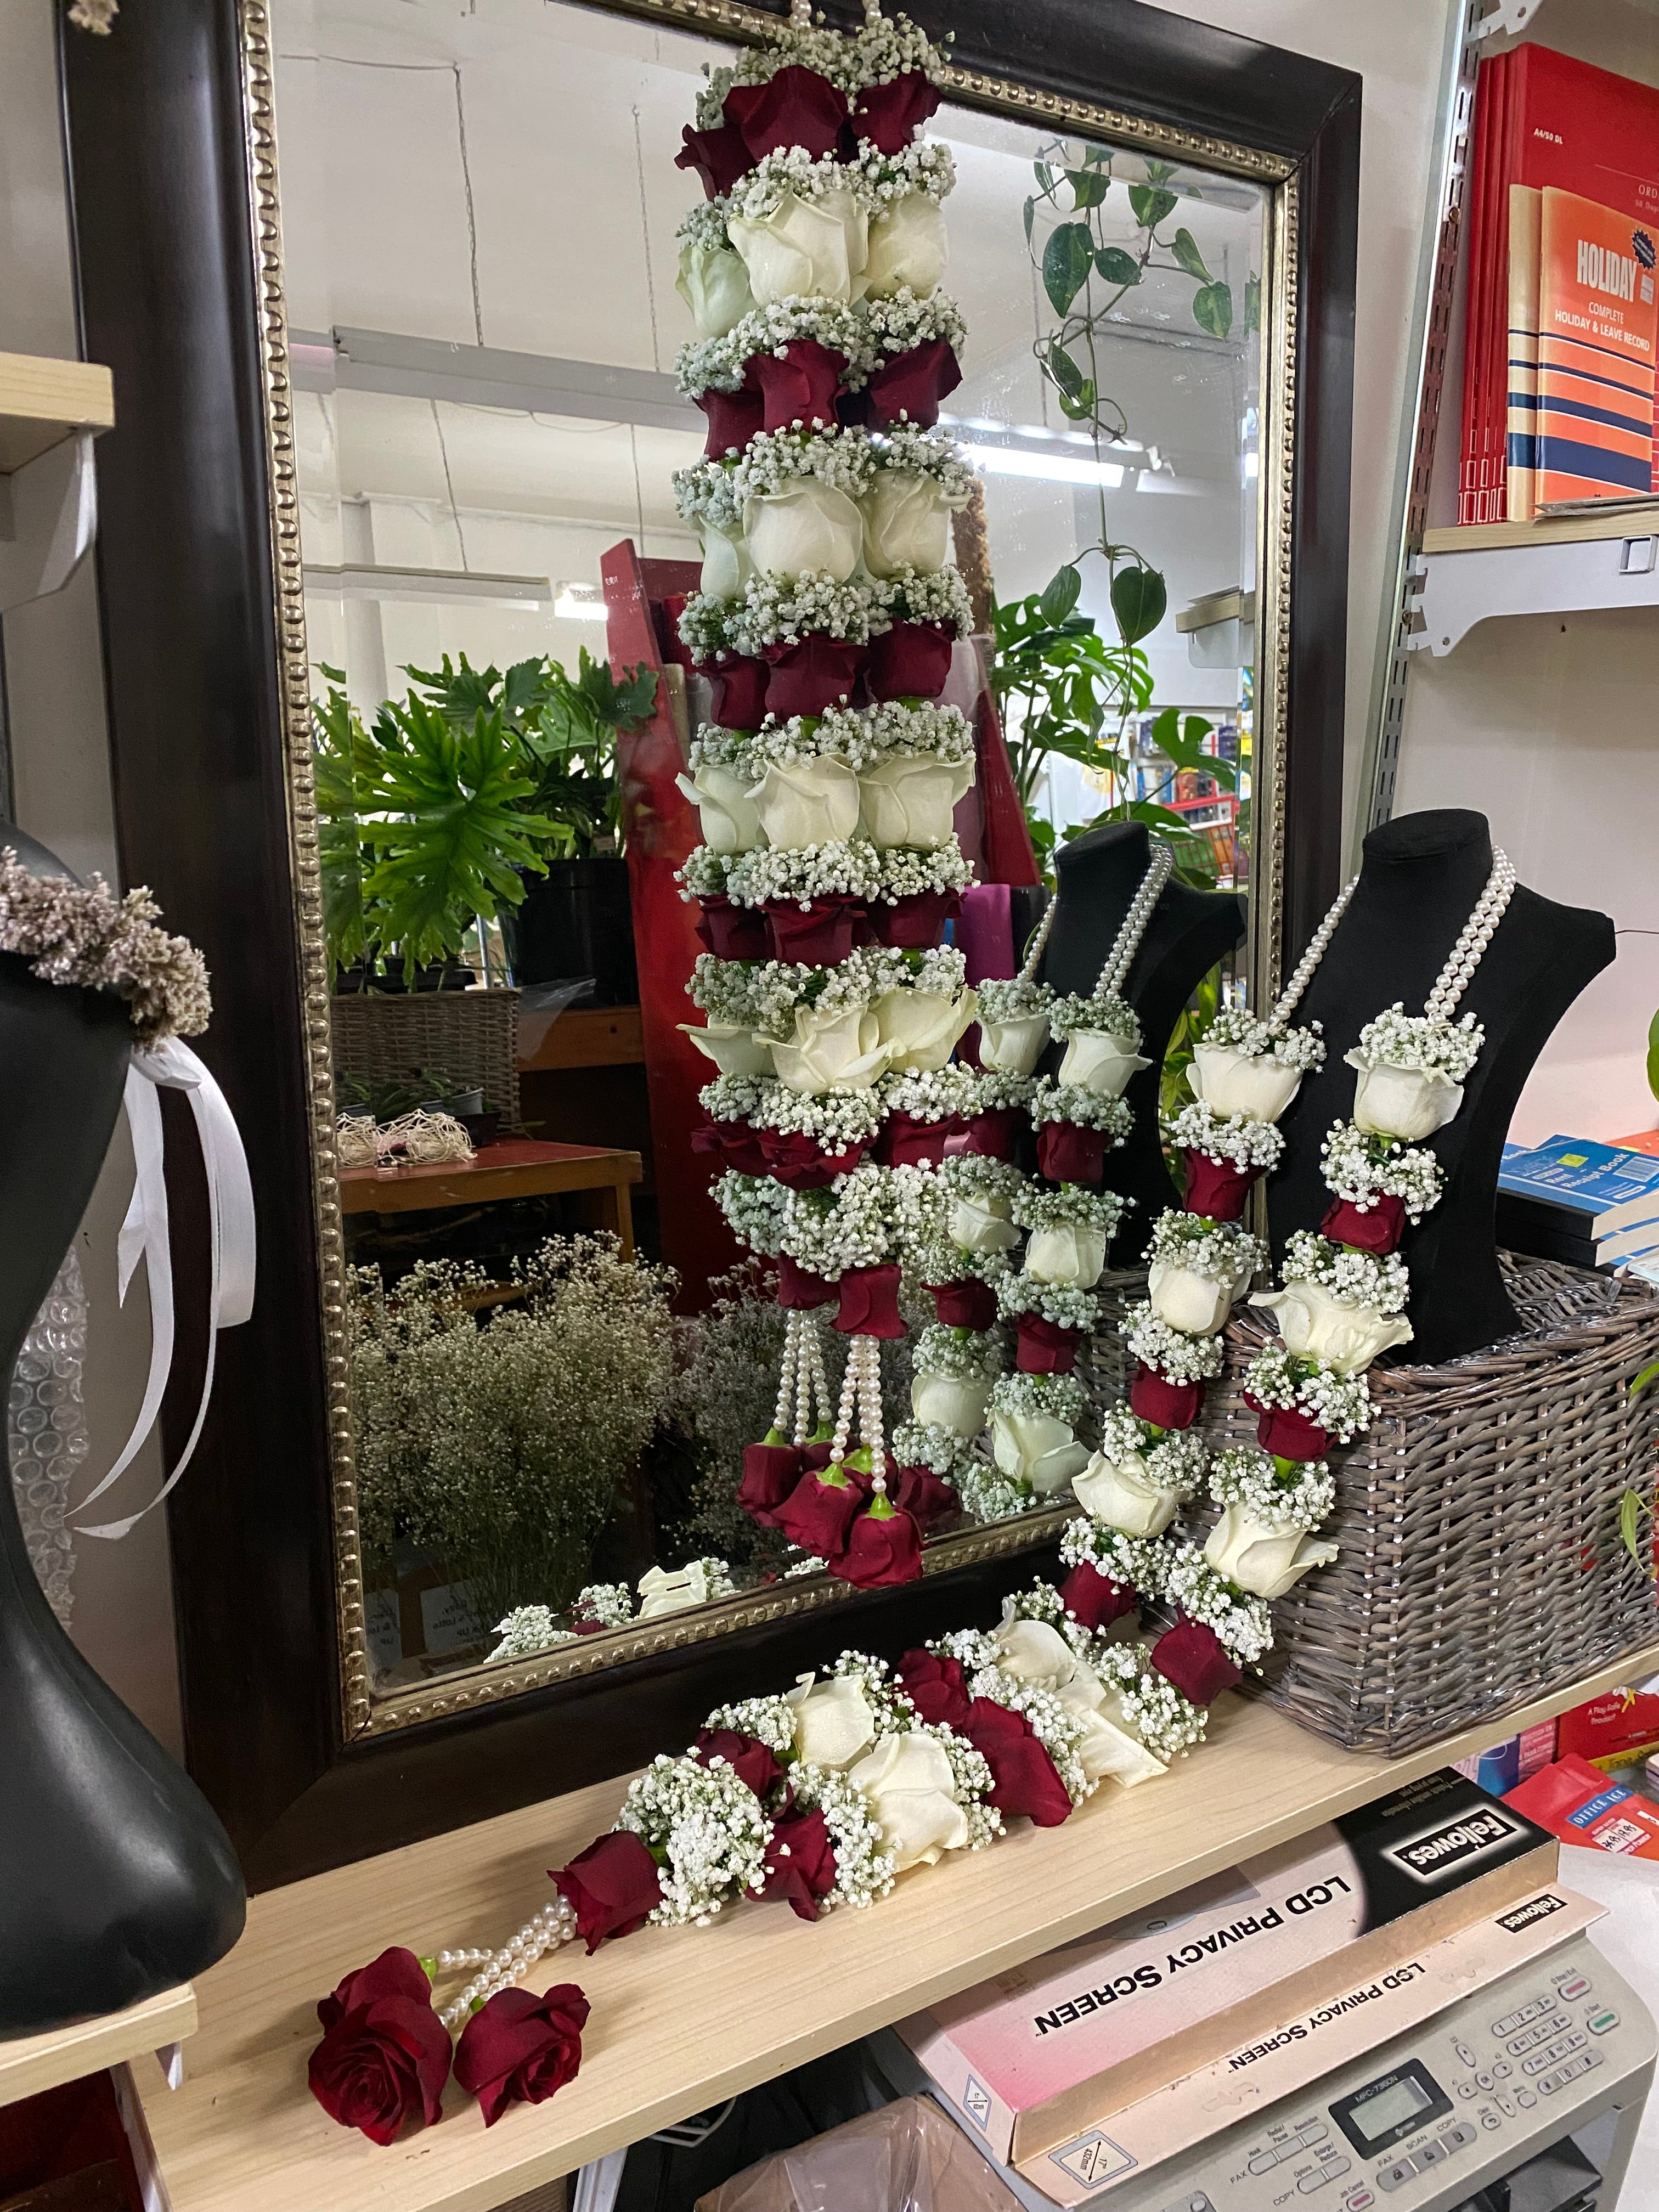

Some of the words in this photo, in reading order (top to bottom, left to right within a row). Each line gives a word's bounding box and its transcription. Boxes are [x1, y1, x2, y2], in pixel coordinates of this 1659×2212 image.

[1533, 128, 1554, 141] A4/50
[1555, 134, 1564, 144] DL
[1577, 239, 1638, 302] HOLIDAY
[1589, 301, 1624, 324] COMPLETE
[1555, 309, 1591, 330] HOLIDAY
[1592, 320, 1599, 334] &
[1600, 323, 1623, 341] LEAVE
[1624, 331, 1650, 351] RECORD
[1545, 1173, 1575, 1184] Rent
[1561, 1171, 1605, 1188] Receipt
[1598, 1153, 1630, 1172] Book
[1573, 1798, 1608, 1824] OFFICE
[1606, 1789, 1627, 1803] ICE
[1406, 1815, 1508, 1865] Fellowes
[1285, 1876, 1352, 1915] LCD
[1503, 1897, 1562, 1928] Fellowes
[1166, 1907, 1285, 1974] PRIVACY
[1034, 1965, 1163, 2036] SCREEN
[1308, 1984, 1384, 2029] PRIVACY
[1518, 2013, 1525, 2021] 2
[1537, 2001, 1545, 2010] 3
[1553, 2019, 1560, 2028] 6
[1228, 2025, 1308, 2070] SCREEN
[1528, 2062, 1534, 2070] 7
[1549, 2050, 1556, 2058] 8
[1568, 2038, 1576, 2046] 9
[1565, 2069, 1572, 2078] 0
[1273, 2133, 1289, 2143] Pause
[1378, 2154, 1394, 2168] FAX
[1406, 2134, 1428, 2150] SCAN
[1436, 2117, 1457, 2132] COPY
[1080, 2148, 1093, 2170] 432mm
[1248, 2147, 1261, 2157] Hook
[1230, 2170, 1248, 2184] FAX
[1294, 2165, 1313, 2178] Options
[1273, 2190, 1295, 2206] COPY
[1348, 2179, 1365, 2193] Cancel
